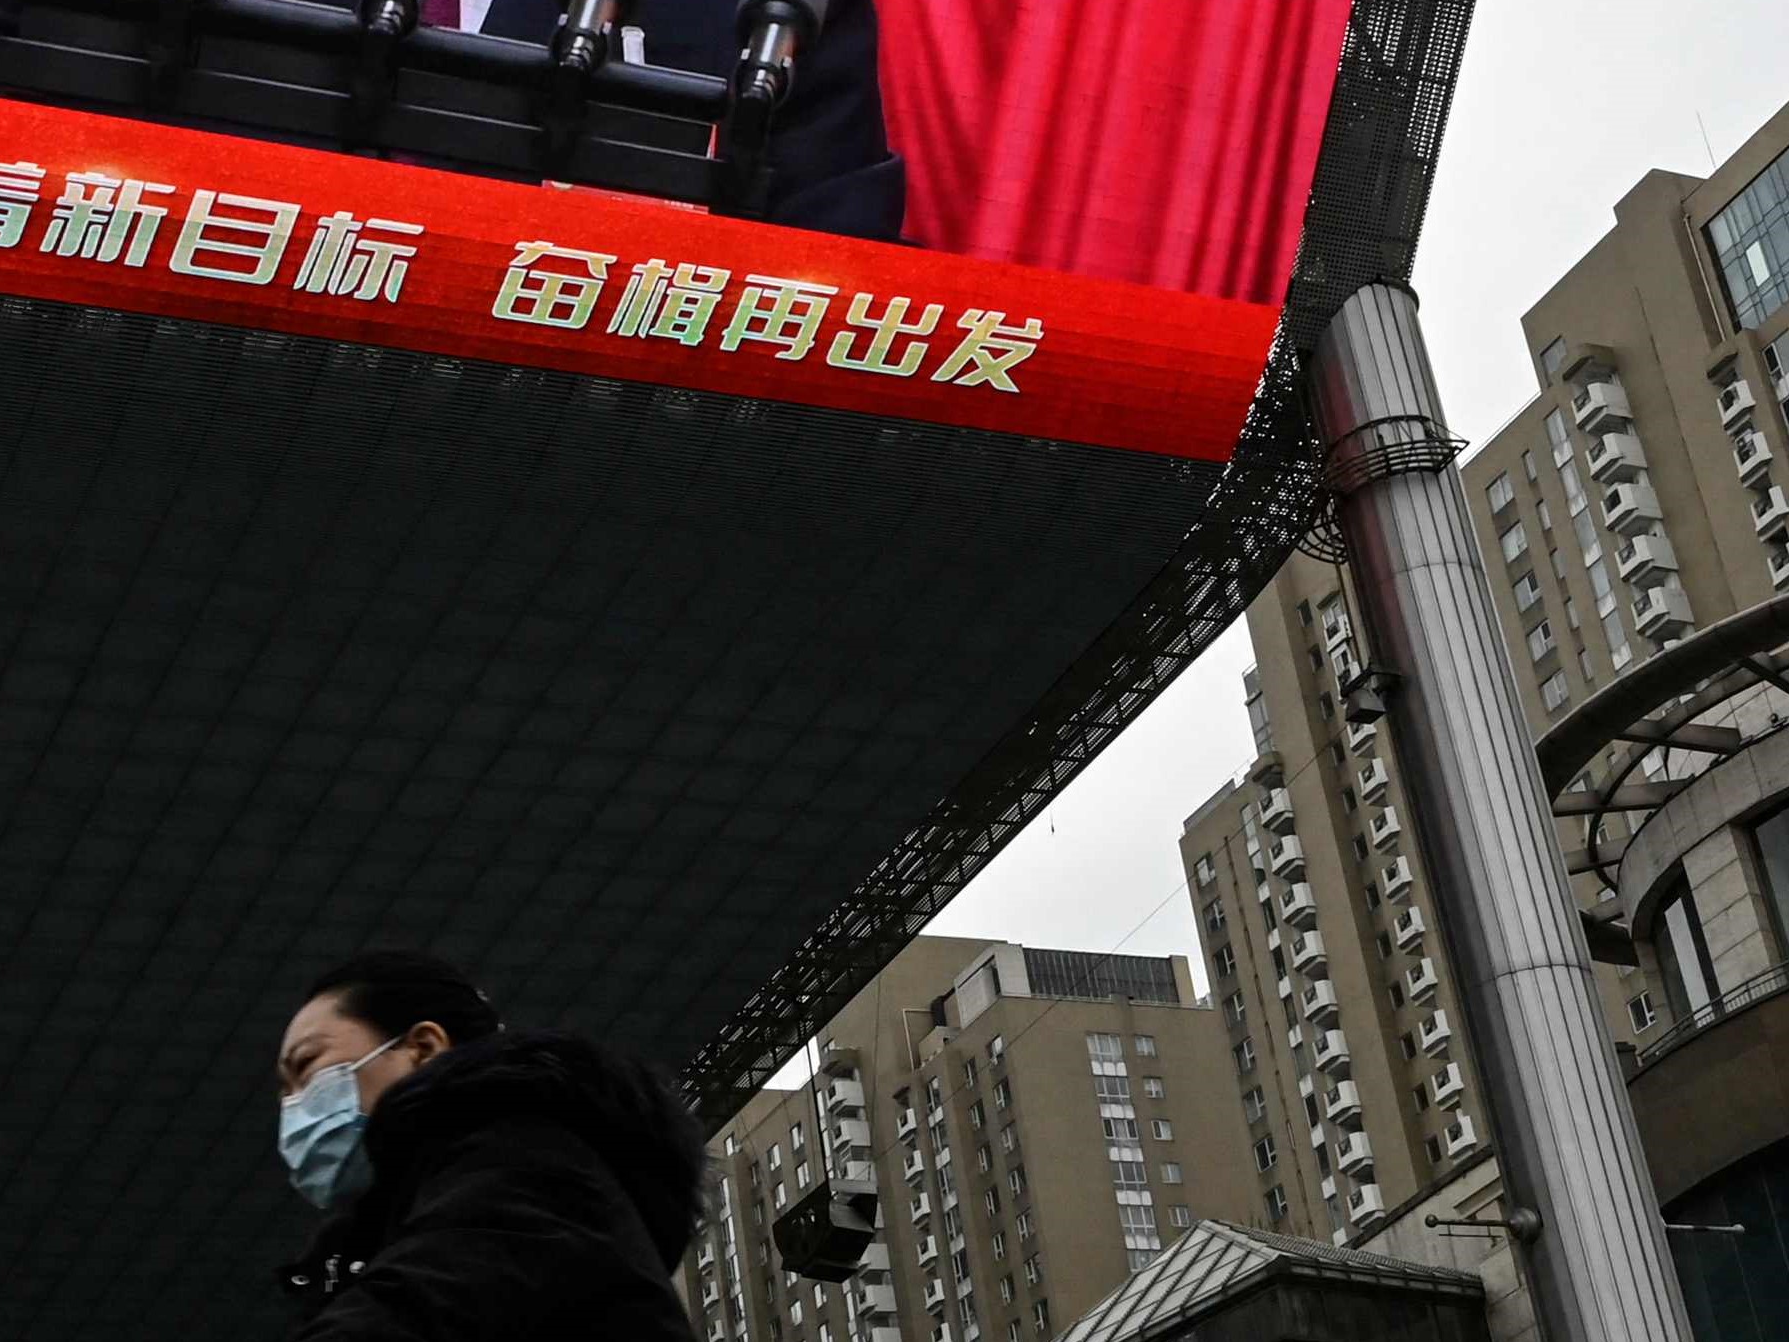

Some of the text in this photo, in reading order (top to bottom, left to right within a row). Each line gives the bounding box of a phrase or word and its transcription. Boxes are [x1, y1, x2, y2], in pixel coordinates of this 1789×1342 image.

[492, 240, 1046, 394] 奋楫再出发
